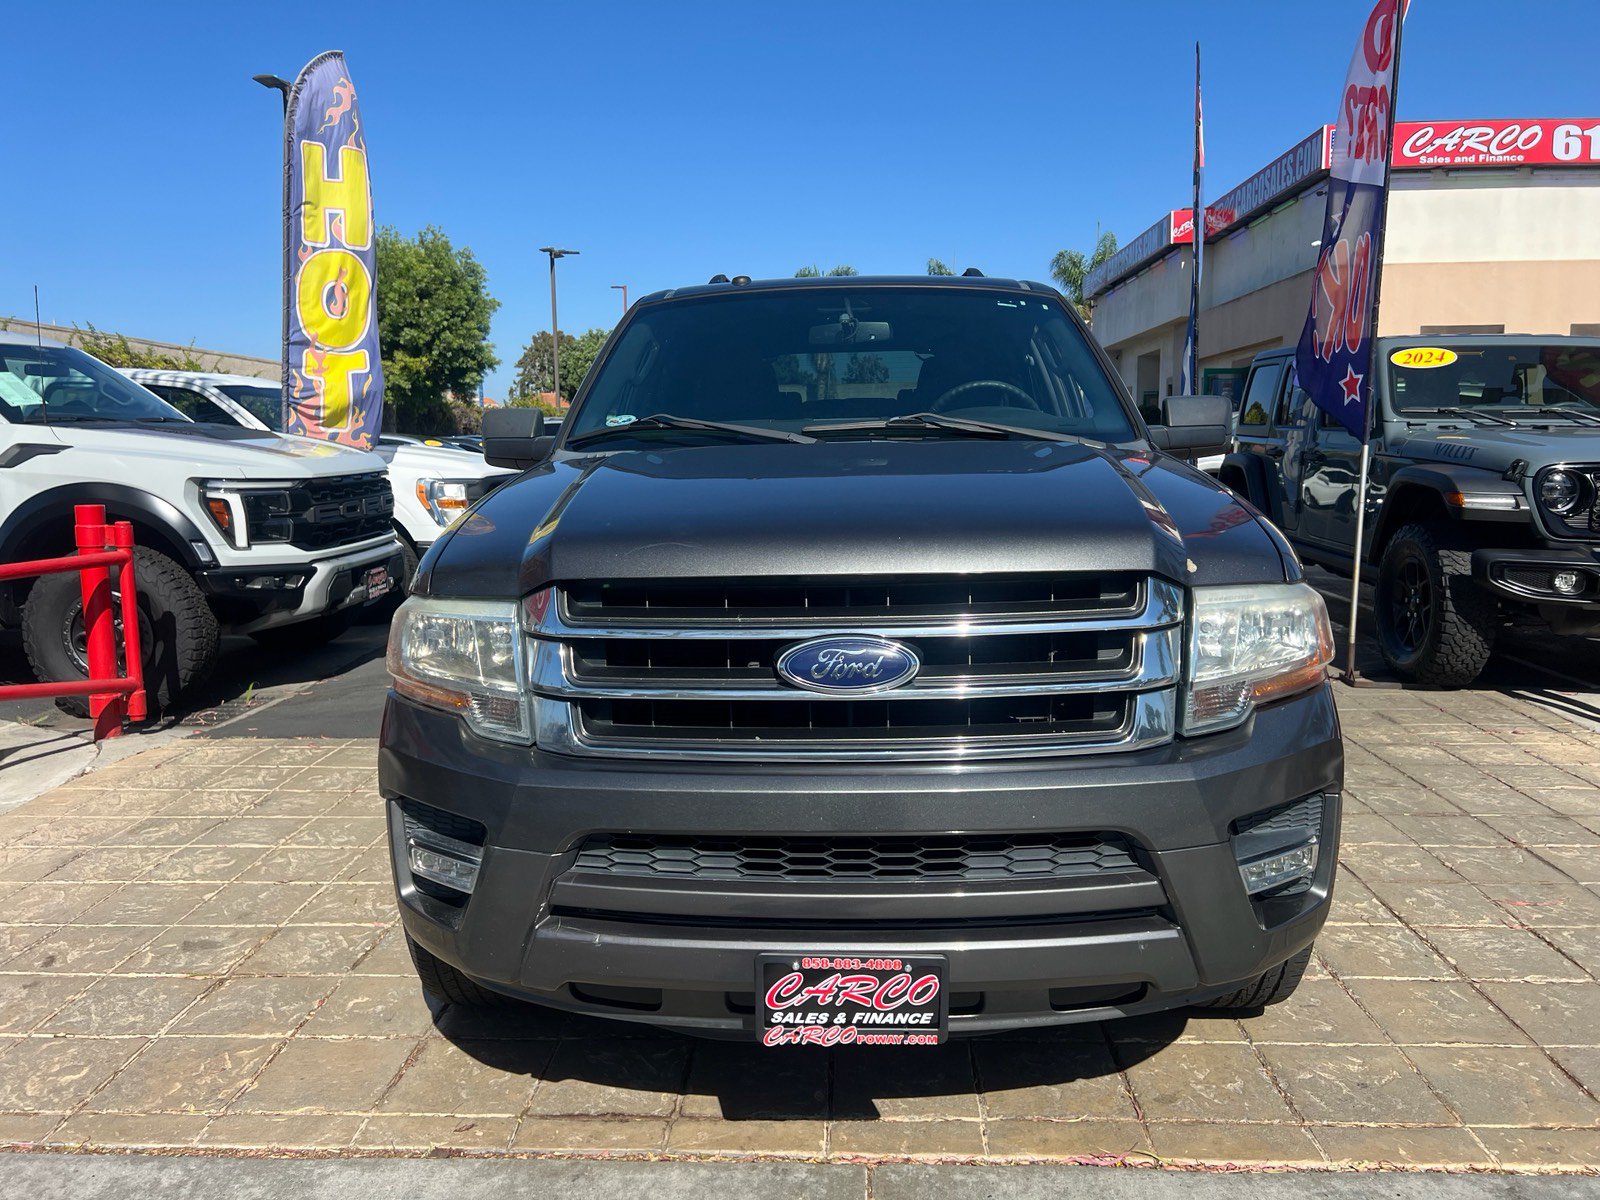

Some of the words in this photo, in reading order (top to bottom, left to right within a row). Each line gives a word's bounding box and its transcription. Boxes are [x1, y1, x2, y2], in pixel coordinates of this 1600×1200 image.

[1402, 124, 1543, 158] CARCO
[1419, 155, 1451, 164] Sales
[1454, 154, 1475, 163] and
[1479, 153, 1524, 163] Finance
[1235, 133, 1322, 218] CARCOSALES.COM
[296, 140, 372, 433] HOT
[1402, 351, 1446, 365] 2024
[810, 648, 885, 681] Ford
[801, 957, 903, 970] 858-883-4888
[765, 971, 940, 1011] CARCO
[770, 1012, 831, 1024] SALES
[833, 1012, 847, 1024] &
[851, 1012, 934, 1024] FINANCE
